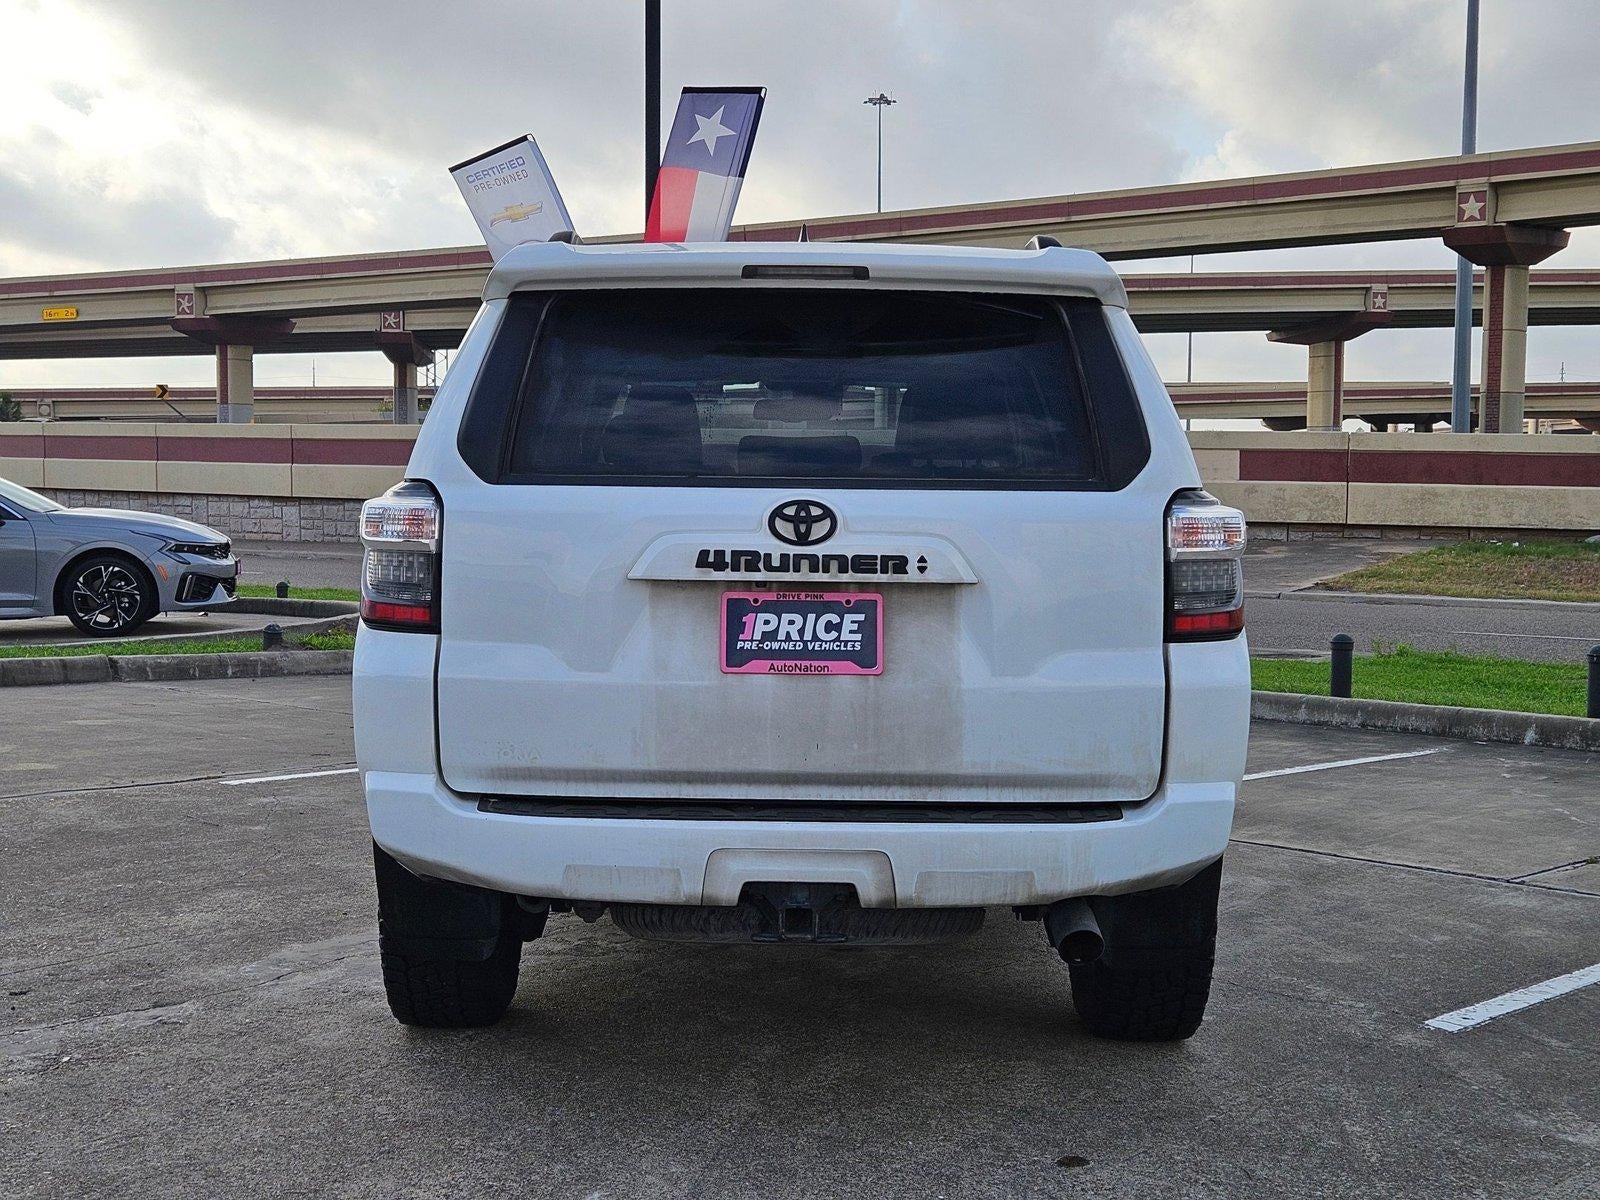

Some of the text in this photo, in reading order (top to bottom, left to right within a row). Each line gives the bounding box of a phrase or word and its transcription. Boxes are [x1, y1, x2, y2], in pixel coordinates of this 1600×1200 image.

[465, 156, 526, 184] CERTIFIED
[473, 169, 529, 194] PRE-OWNED
[695, 549, 909, 575] 4RUNNER
[738, 613, 866, 641] 1PRICE
[736, 641, 861, 651] PRE-OWNED VEHICLES
[768, 662, 830, 673] AutoNation
